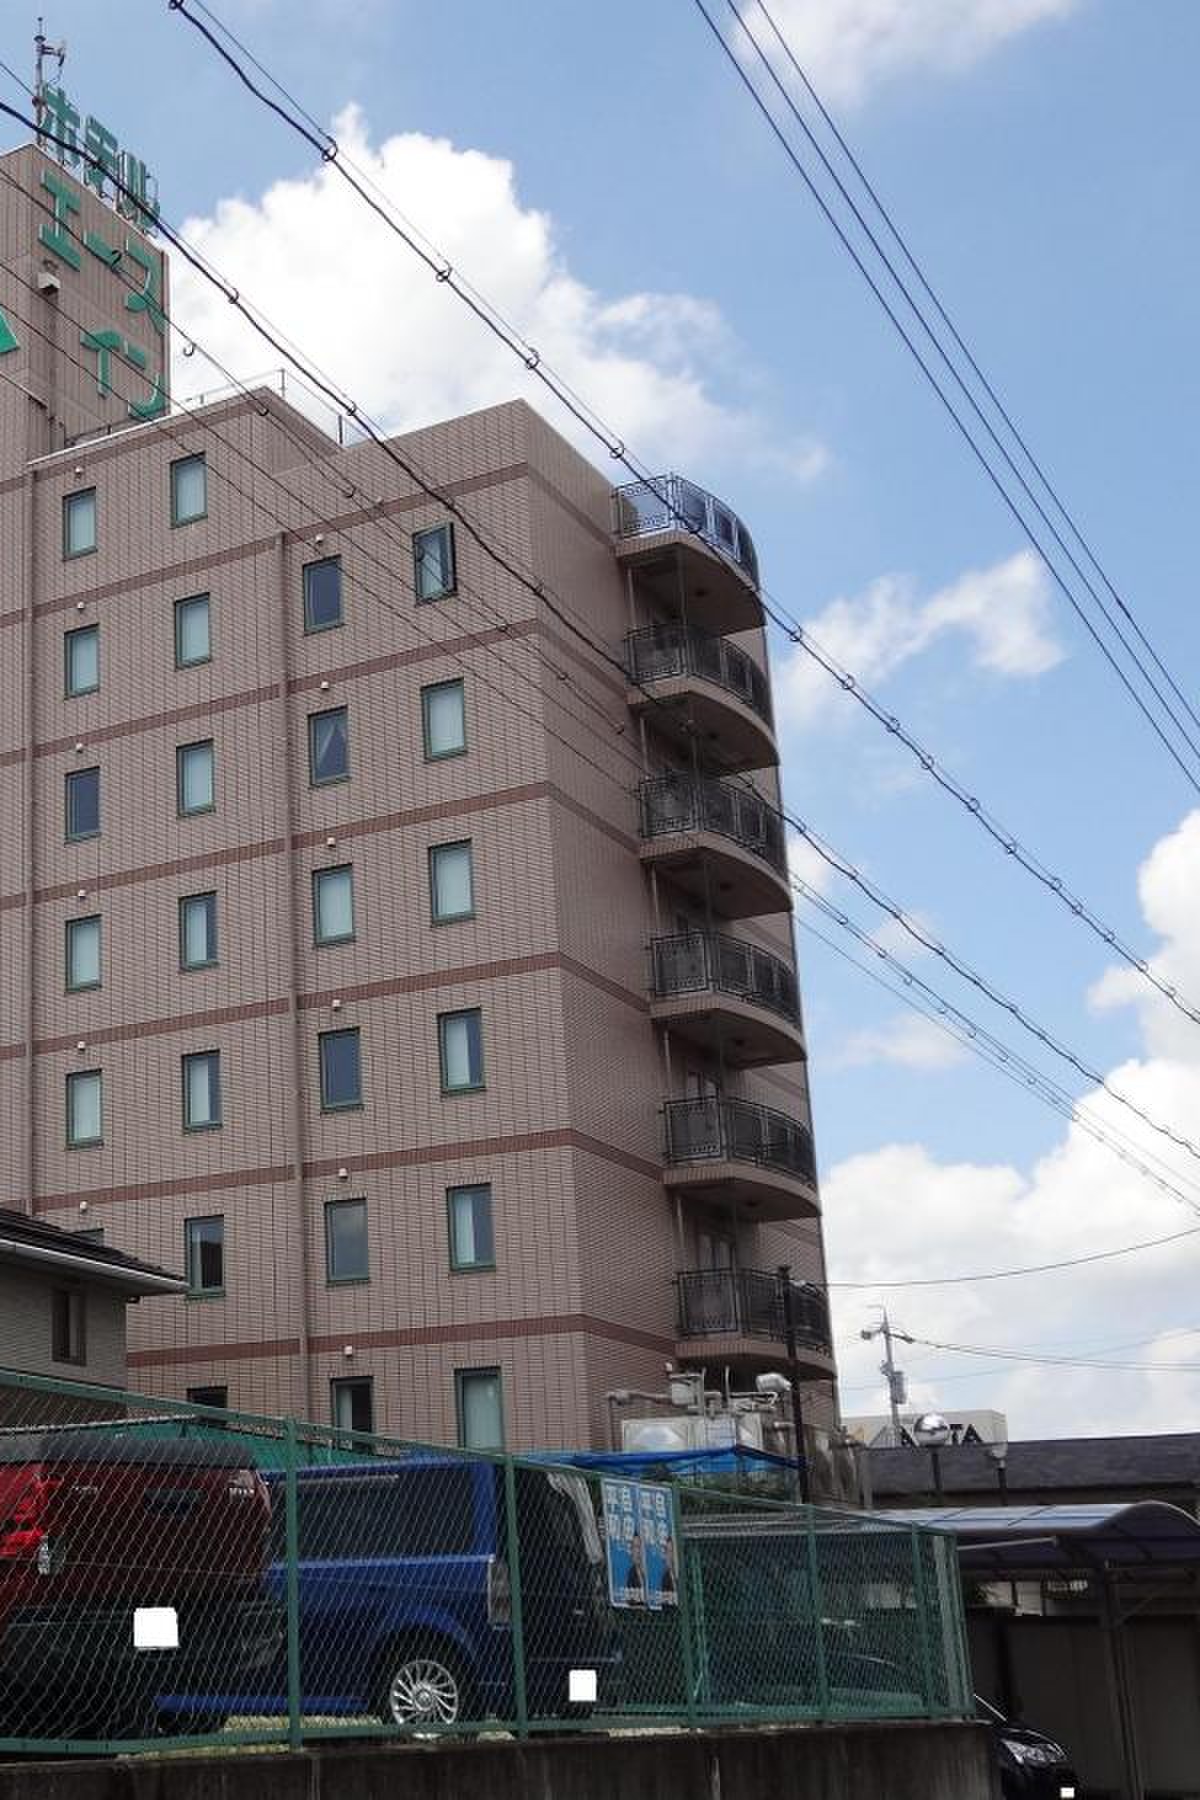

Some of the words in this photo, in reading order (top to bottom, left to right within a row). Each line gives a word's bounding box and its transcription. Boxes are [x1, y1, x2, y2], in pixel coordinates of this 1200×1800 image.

[39, 80, 161, 238] ホテル
[37, 169, 167, 336] エース
[79, 330, 167, 423] イン
